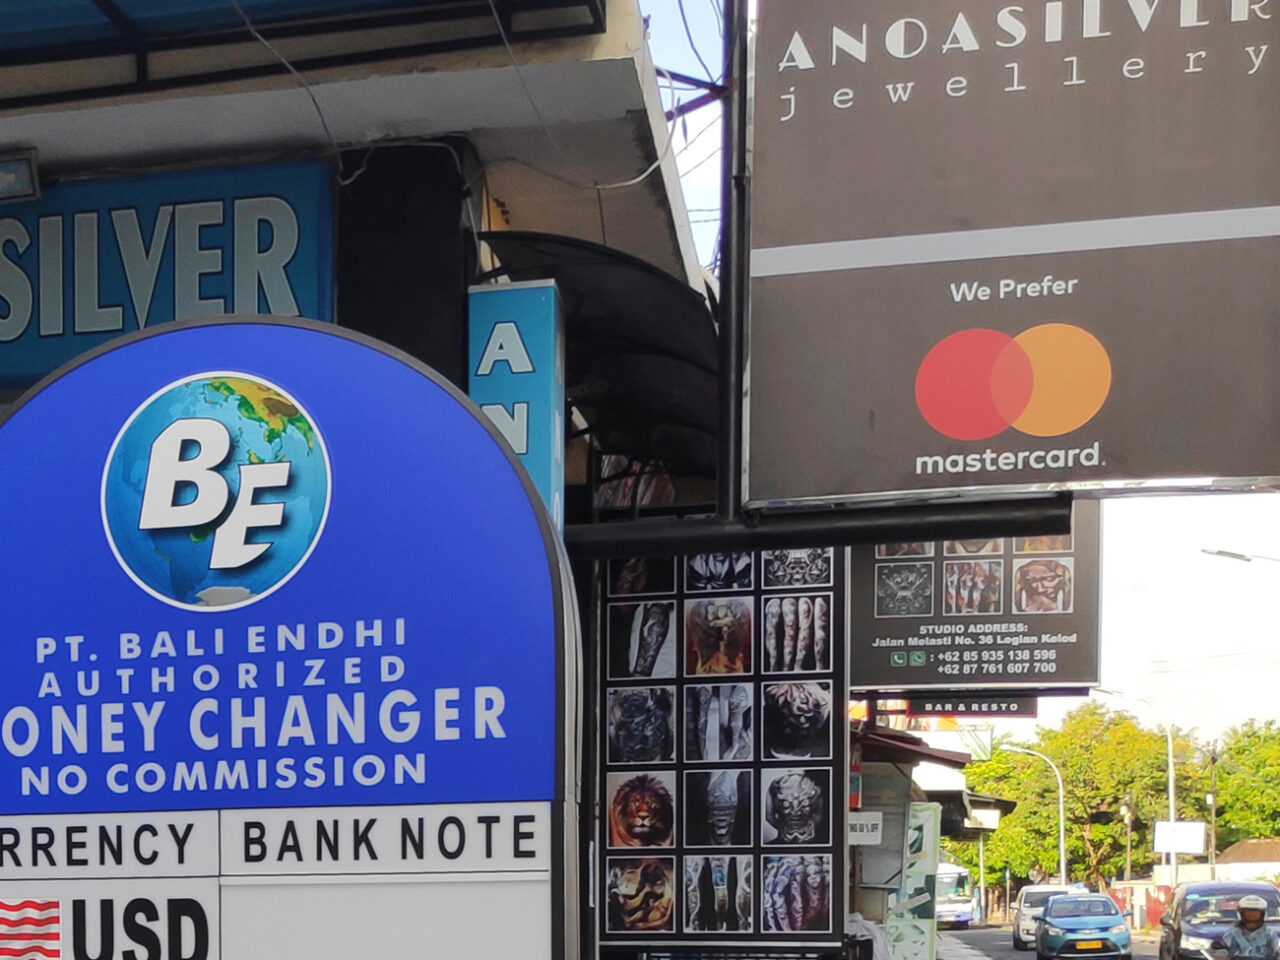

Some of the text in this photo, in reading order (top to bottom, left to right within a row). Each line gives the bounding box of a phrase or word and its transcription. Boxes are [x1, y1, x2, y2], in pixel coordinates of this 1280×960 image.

[779, 44, 1269, 121] jewellery
[950, 275, 1078, 302] We Prefer
[137, 417, 292, 570] BE
[36, 618, 407, 664] PT. BALI ENDHI
[872, 637, 905, 648] Jalan
[954, 635, 975, 646] No.
[978, 634, 994, 645] 36
[997, 634, 1039, 647] Legian
[919, 623, 1029, 635] STUDIO ADDRESS:
[38, 655, 406, 698] AUTHORIZED
[937, 663, 1057, 675] +62 87 761 607 700
[938, 651, 960, 662] +62
[963, 651, 979, 661] 85
[981, 650, 1004, 661] 935
[1007, 650, 1030, 661] 138
[1033, 650, 1057, 660] 596
[189, 685, 507, 750] CHANGER
[924, 702, 1019, 712] BAR & RESTO
[21, 753, 426, 796] NO COMMISSION
[243, 818, 378, 863] BANK
[400, 814, 538, 860] NOTE
